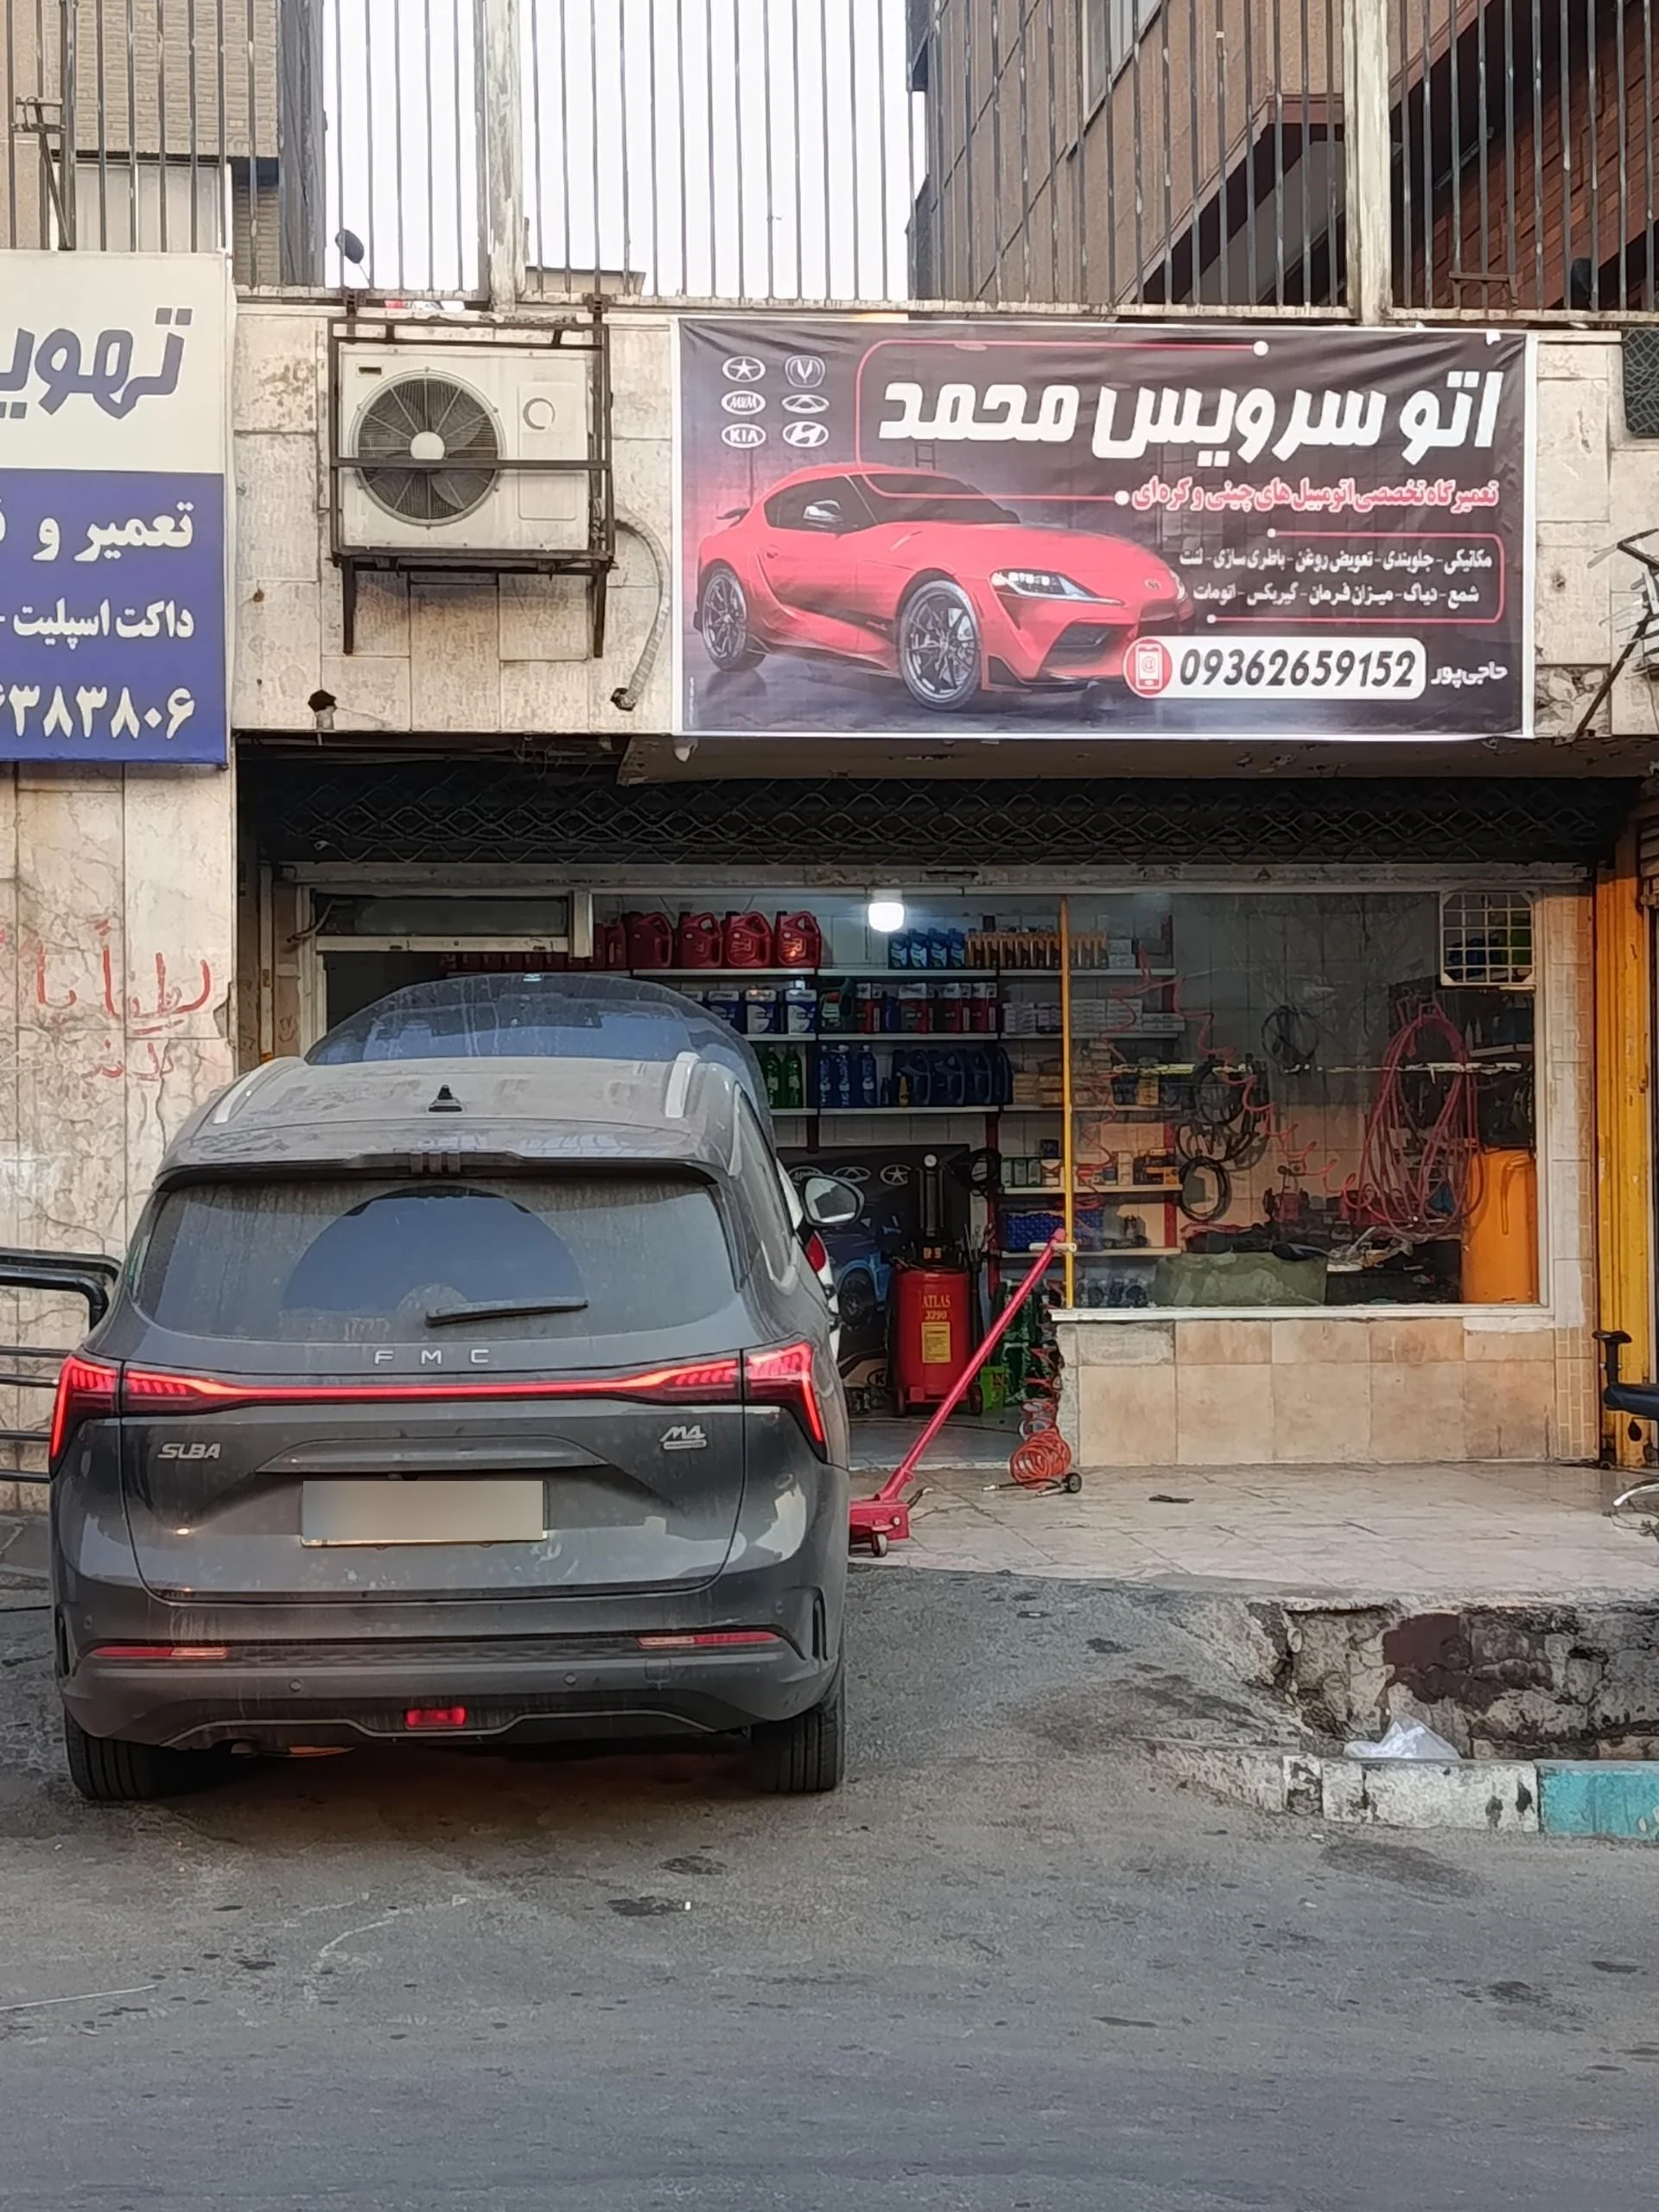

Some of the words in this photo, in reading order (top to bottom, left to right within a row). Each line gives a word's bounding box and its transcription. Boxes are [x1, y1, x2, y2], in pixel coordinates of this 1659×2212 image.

[0, 307, 193, 420] تهوی
[878, 382, 1080, 442] محمد
[1398, 371, 1504, 466] اتو
[729, 429, 760, 442] KIA
[1091, 385, 1387, 467] سرویس
[1190, 486, 1205, 512] و
[1205, 480, 1255, 512] چینی
[1354, 479, 1427, 512] تخصصی
[32, 518, 60, 561] و
[73, 501, 194, 562] تعمیر
[1179, 547, 1204, 565] لنت
[1294, 548, 1329, 572] روغن
[1329, 550, 1374, 573] تعویض
[1382, 548, 1434, 573] جلوبندی
[1444, 549, 1492, 575] مکانیکی
[1192, 582, 1236, 605] اتومات
[1246, 581, 1299, 606] گیربکس
[1309, 582, 1351, 606] فرمان
[1351, 583, 1394, 606] میزان
[1447, 585, 1479, 609] شمع
[13, 597, 110, 650] اسپلیت
[115, 600, 194, 638] داکت
[1179, 648, 1416, 687] 09362659152
[0, 683, 195, 740] ۳۸۳۸۰۶
[922, 1294, 951, 1308] ATLAS
[659, 1425, 706, 1442] M4
